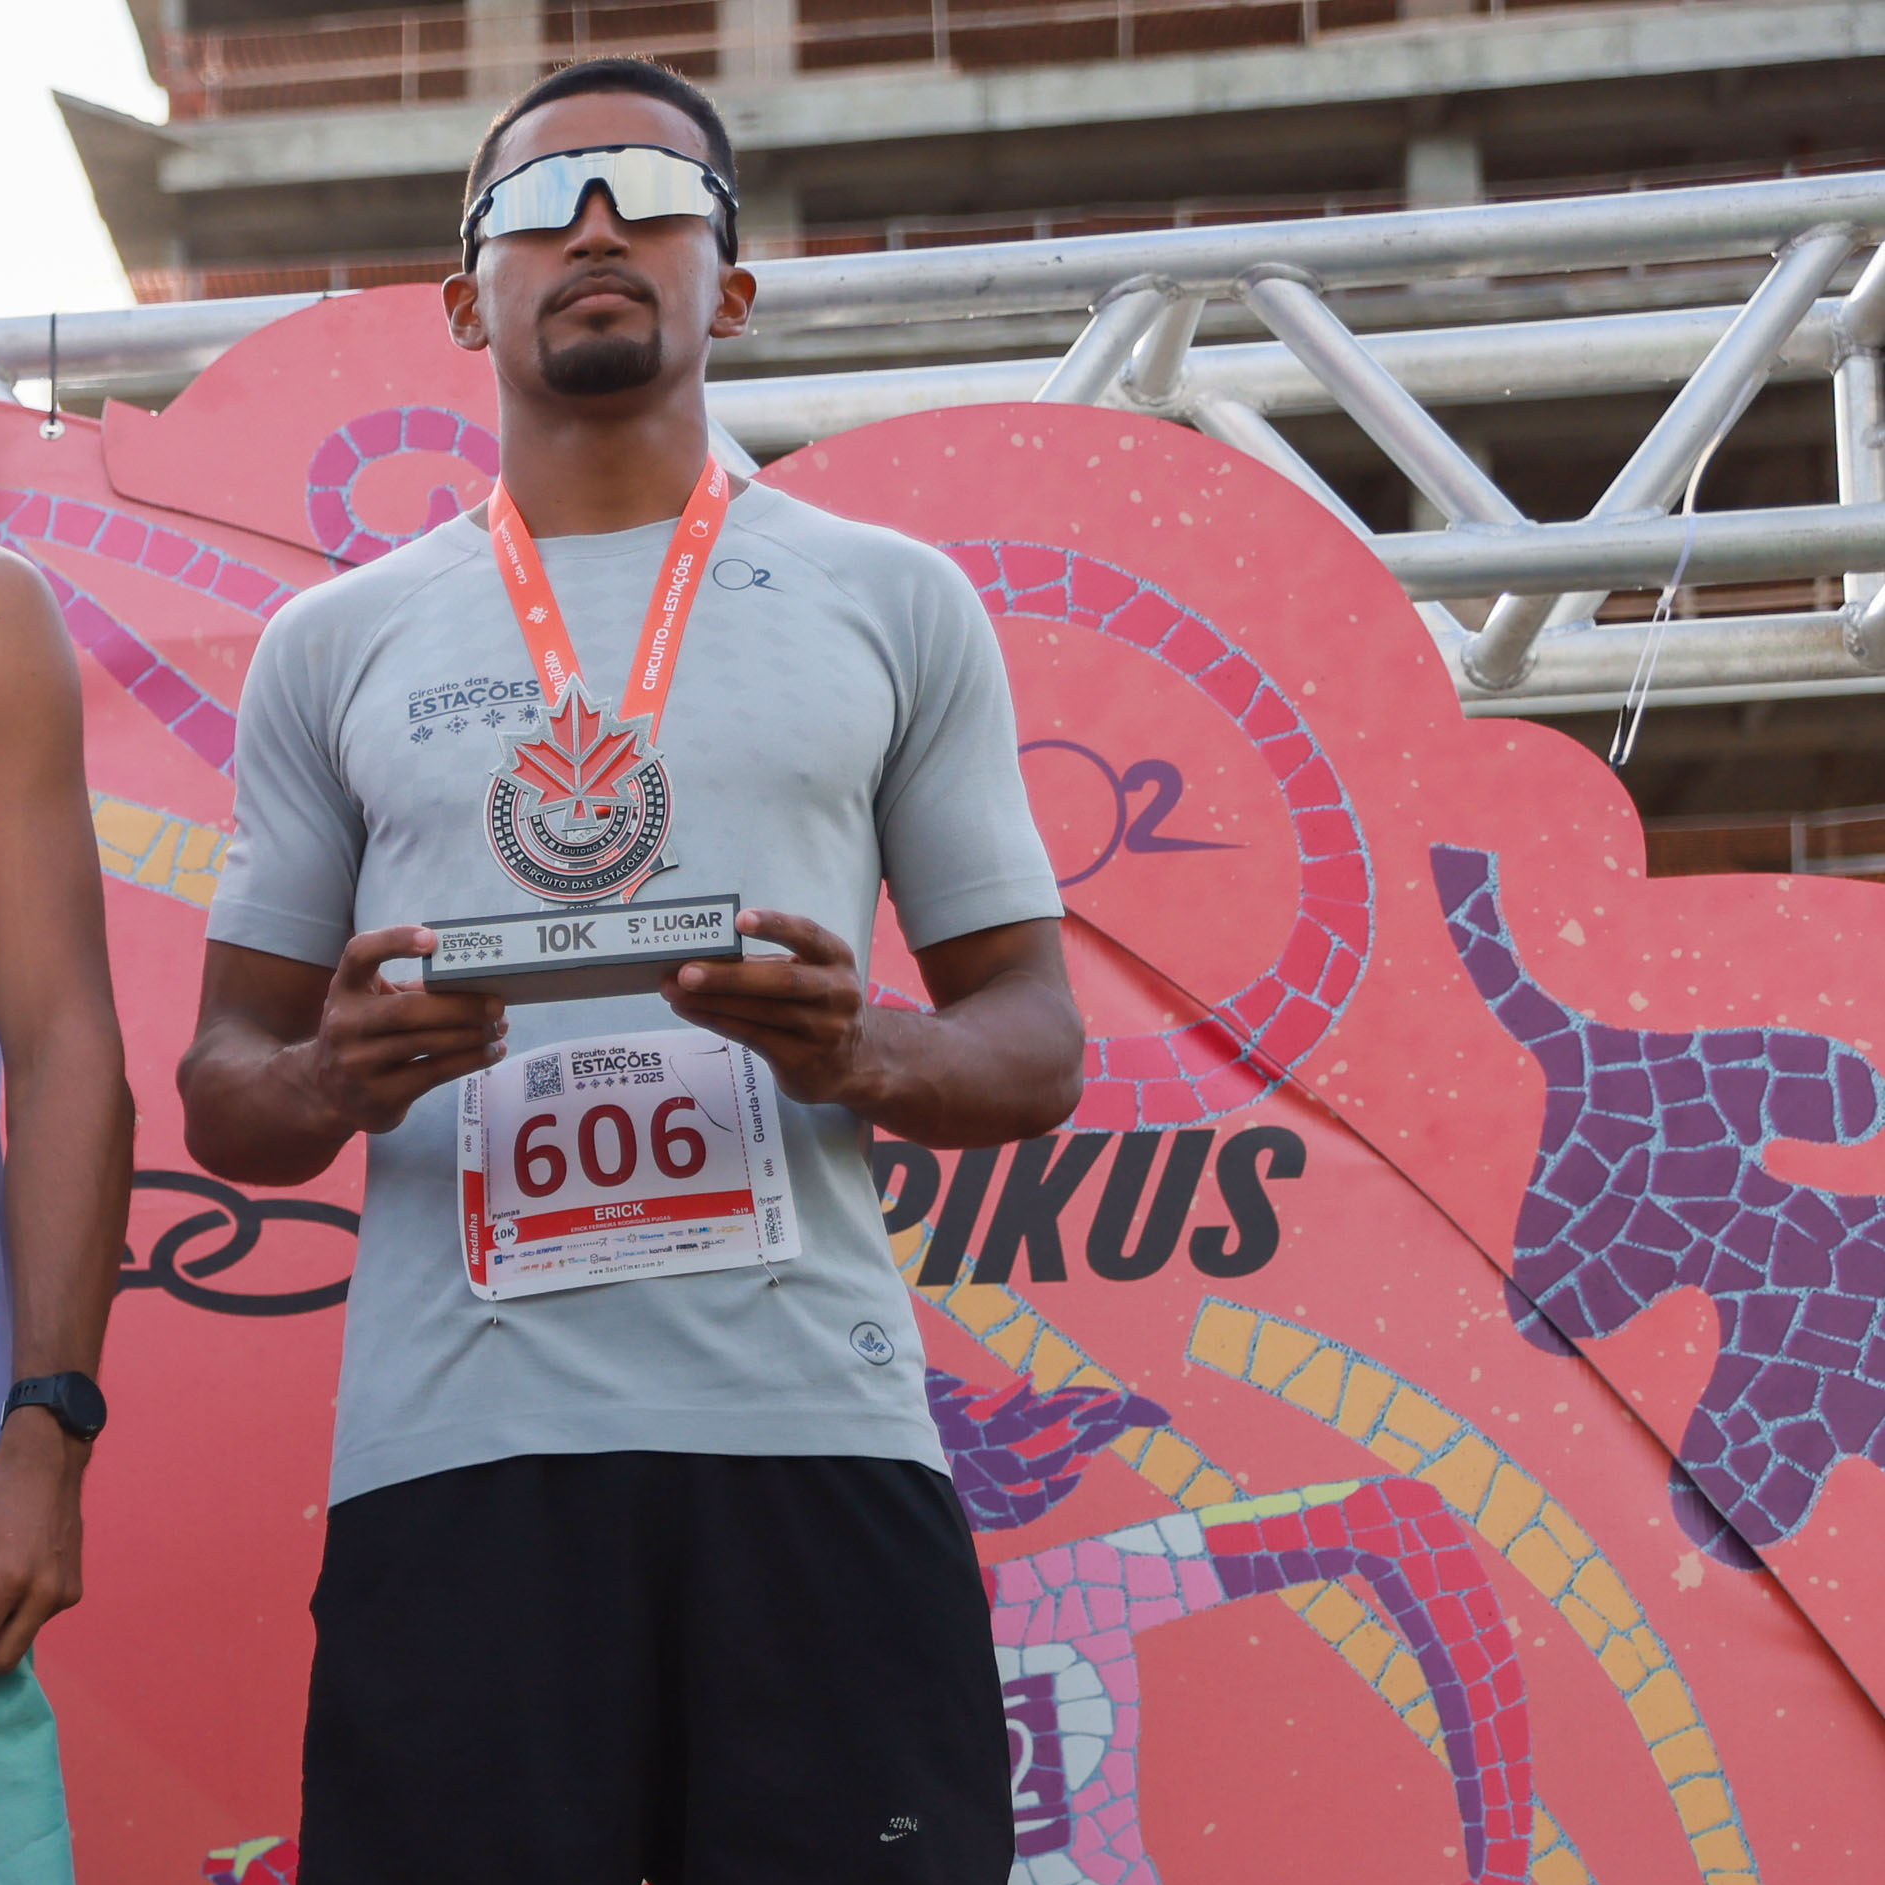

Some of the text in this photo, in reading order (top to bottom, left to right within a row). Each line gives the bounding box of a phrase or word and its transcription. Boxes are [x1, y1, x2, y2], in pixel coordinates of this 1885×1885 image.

[642, 553, 694, 691] CIRCUITO DAS ESTAÇÕES
[408, 676, 490, 702] Circuito das
[408, 680, 540, 719] ESTAÇÕES
[520, 847, 646, 890] CIRCUITO DAS ESTAÇÕES
[652, 911, 723, 933] LUGAR
[442, 934, 504, 951] ESTAÇÕES
[536, 921, 598, 954] 10K
[631, 930, 721, 946] MASCULINO
[571, 1046, 626, 1060] Circuito das
[571, 1051, 662, 1076] ESTAÇÕES
[633, 1071, 665, 1084] 2025
[739, 1046, 764, 1143] Guarda-Volume
[514, 1096, 707, 1198] 606
[764, 1158, 775, 1177] 606
[492, 1208, 521, 1222] Palmas
[594, 1202, 646, 1222] ERICK
[469, 1213, 480, 1266] Medalha
[494, 1227, 516, 1241] 10K
